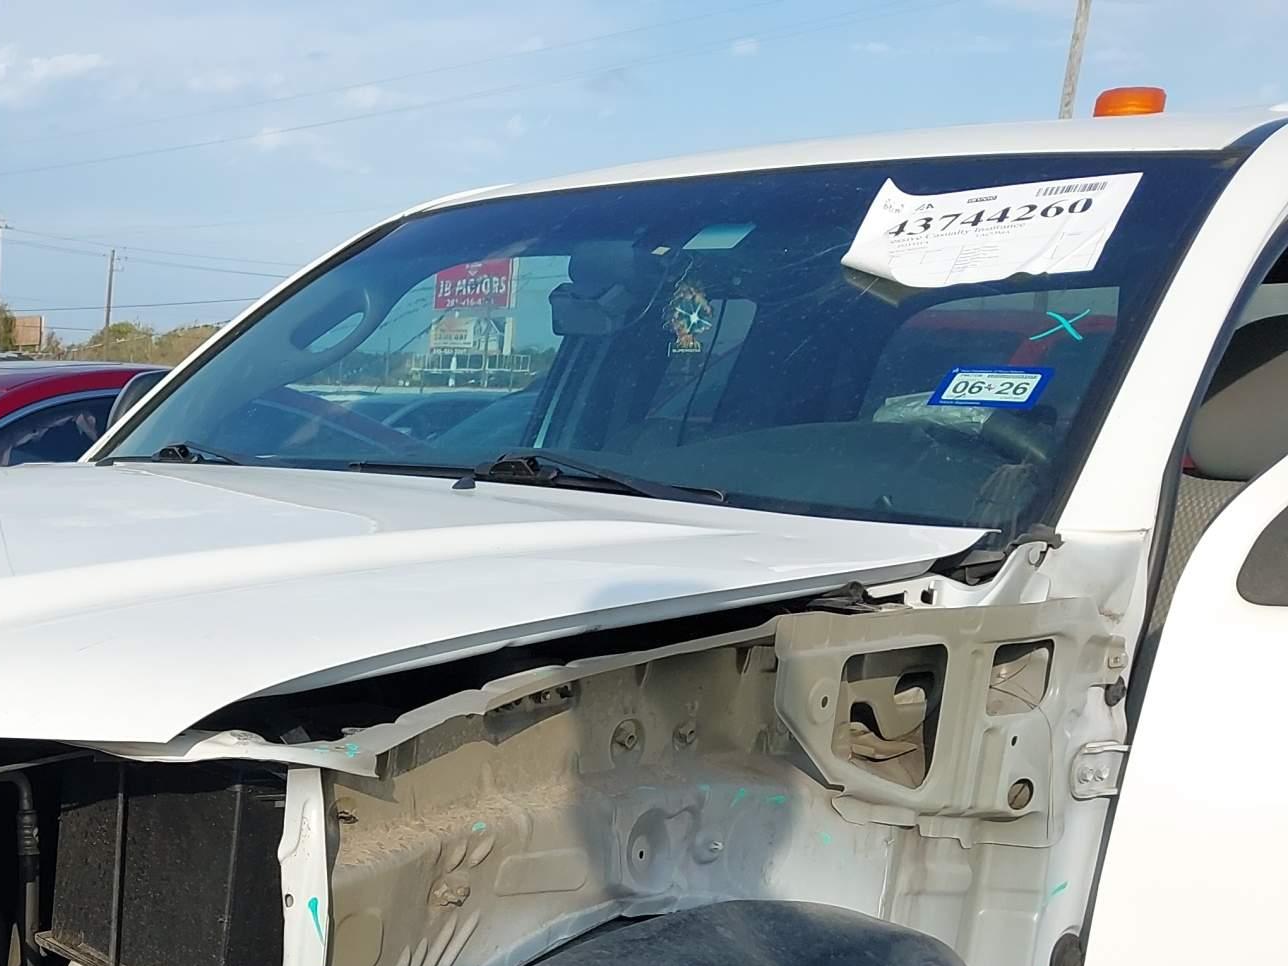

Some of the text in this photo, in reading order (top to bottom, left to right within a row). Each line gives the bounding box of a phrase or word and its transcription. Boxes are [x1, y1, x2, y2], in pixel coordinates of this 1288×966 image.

[885, 197, 1093, 237] 43744260
[455, 275, 507, 297] MOTORS
[952, 380, 1031, 396] 06 26
